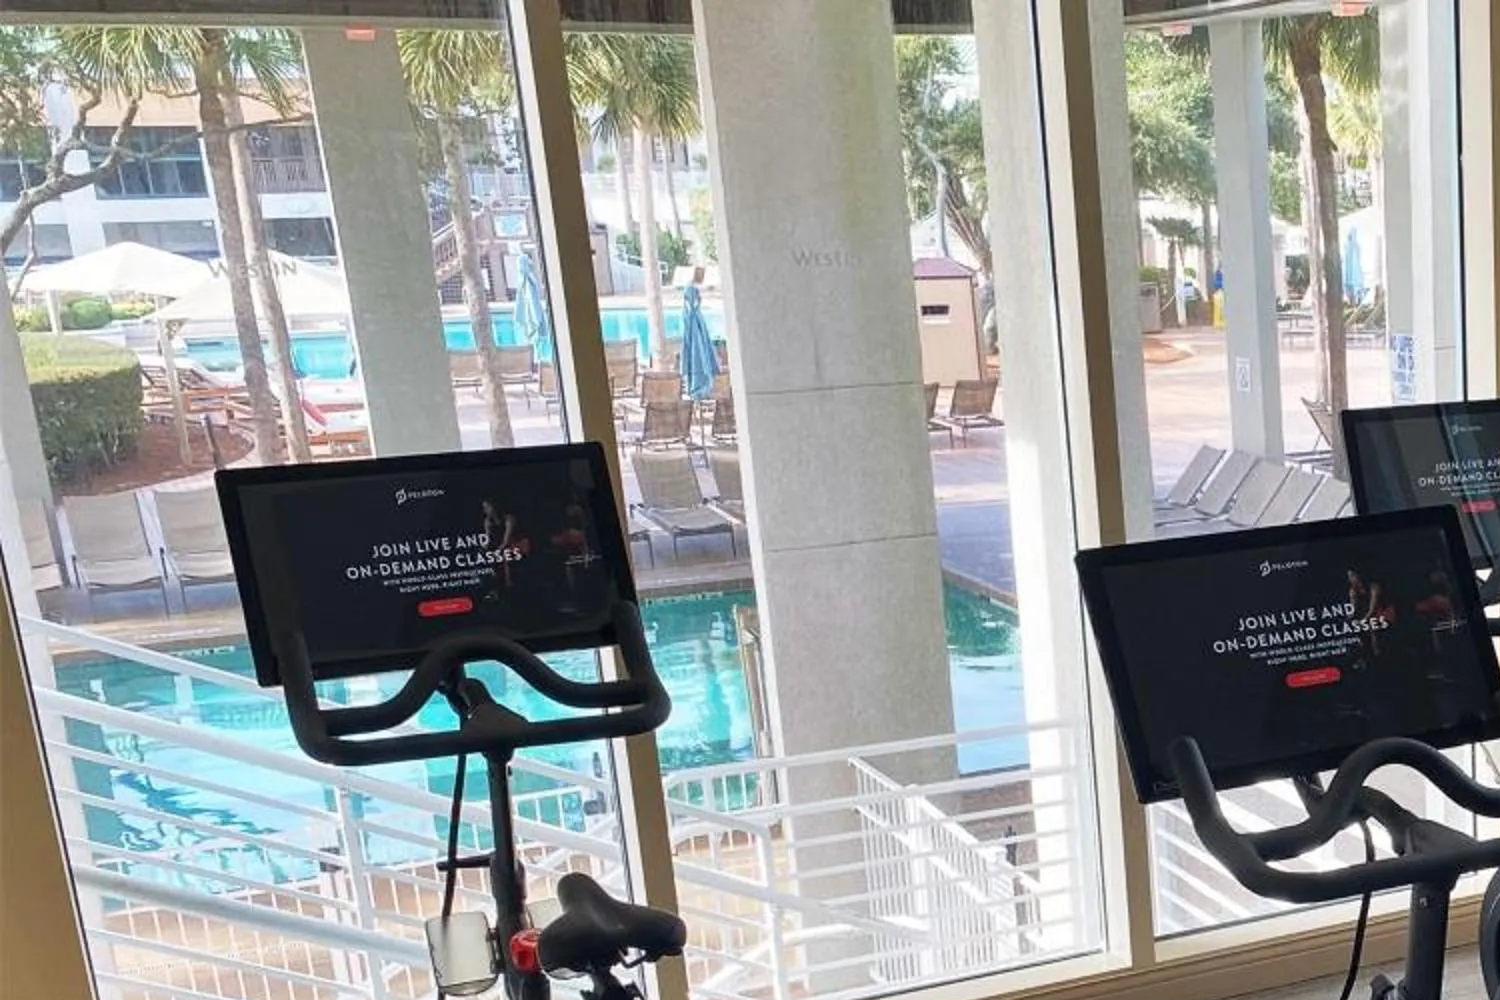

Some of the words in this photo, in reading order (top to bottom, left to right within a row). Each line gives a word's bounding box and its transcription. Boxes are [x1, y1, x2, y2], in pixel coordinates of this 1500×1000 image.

[1418, 472, 1483, 487] ONDEMAND
[372, 541, 411, 559] JOIN
[415, 537, 452, 554] LIVE
[456, 533, 490, 549] AND
[346, 556, 450, 580] ON-DEMAND
[455, 547, 523, 567] CLASSES
[1238, 614, 1277, 631] JOIN
[1281, 607, 1317, 625] LIVE
[1321, 603, 1355, 619] AND
[1213, 627, 1317, 653] ON-DEMAND
[1321, 615, 1389, 638] CLASSES
